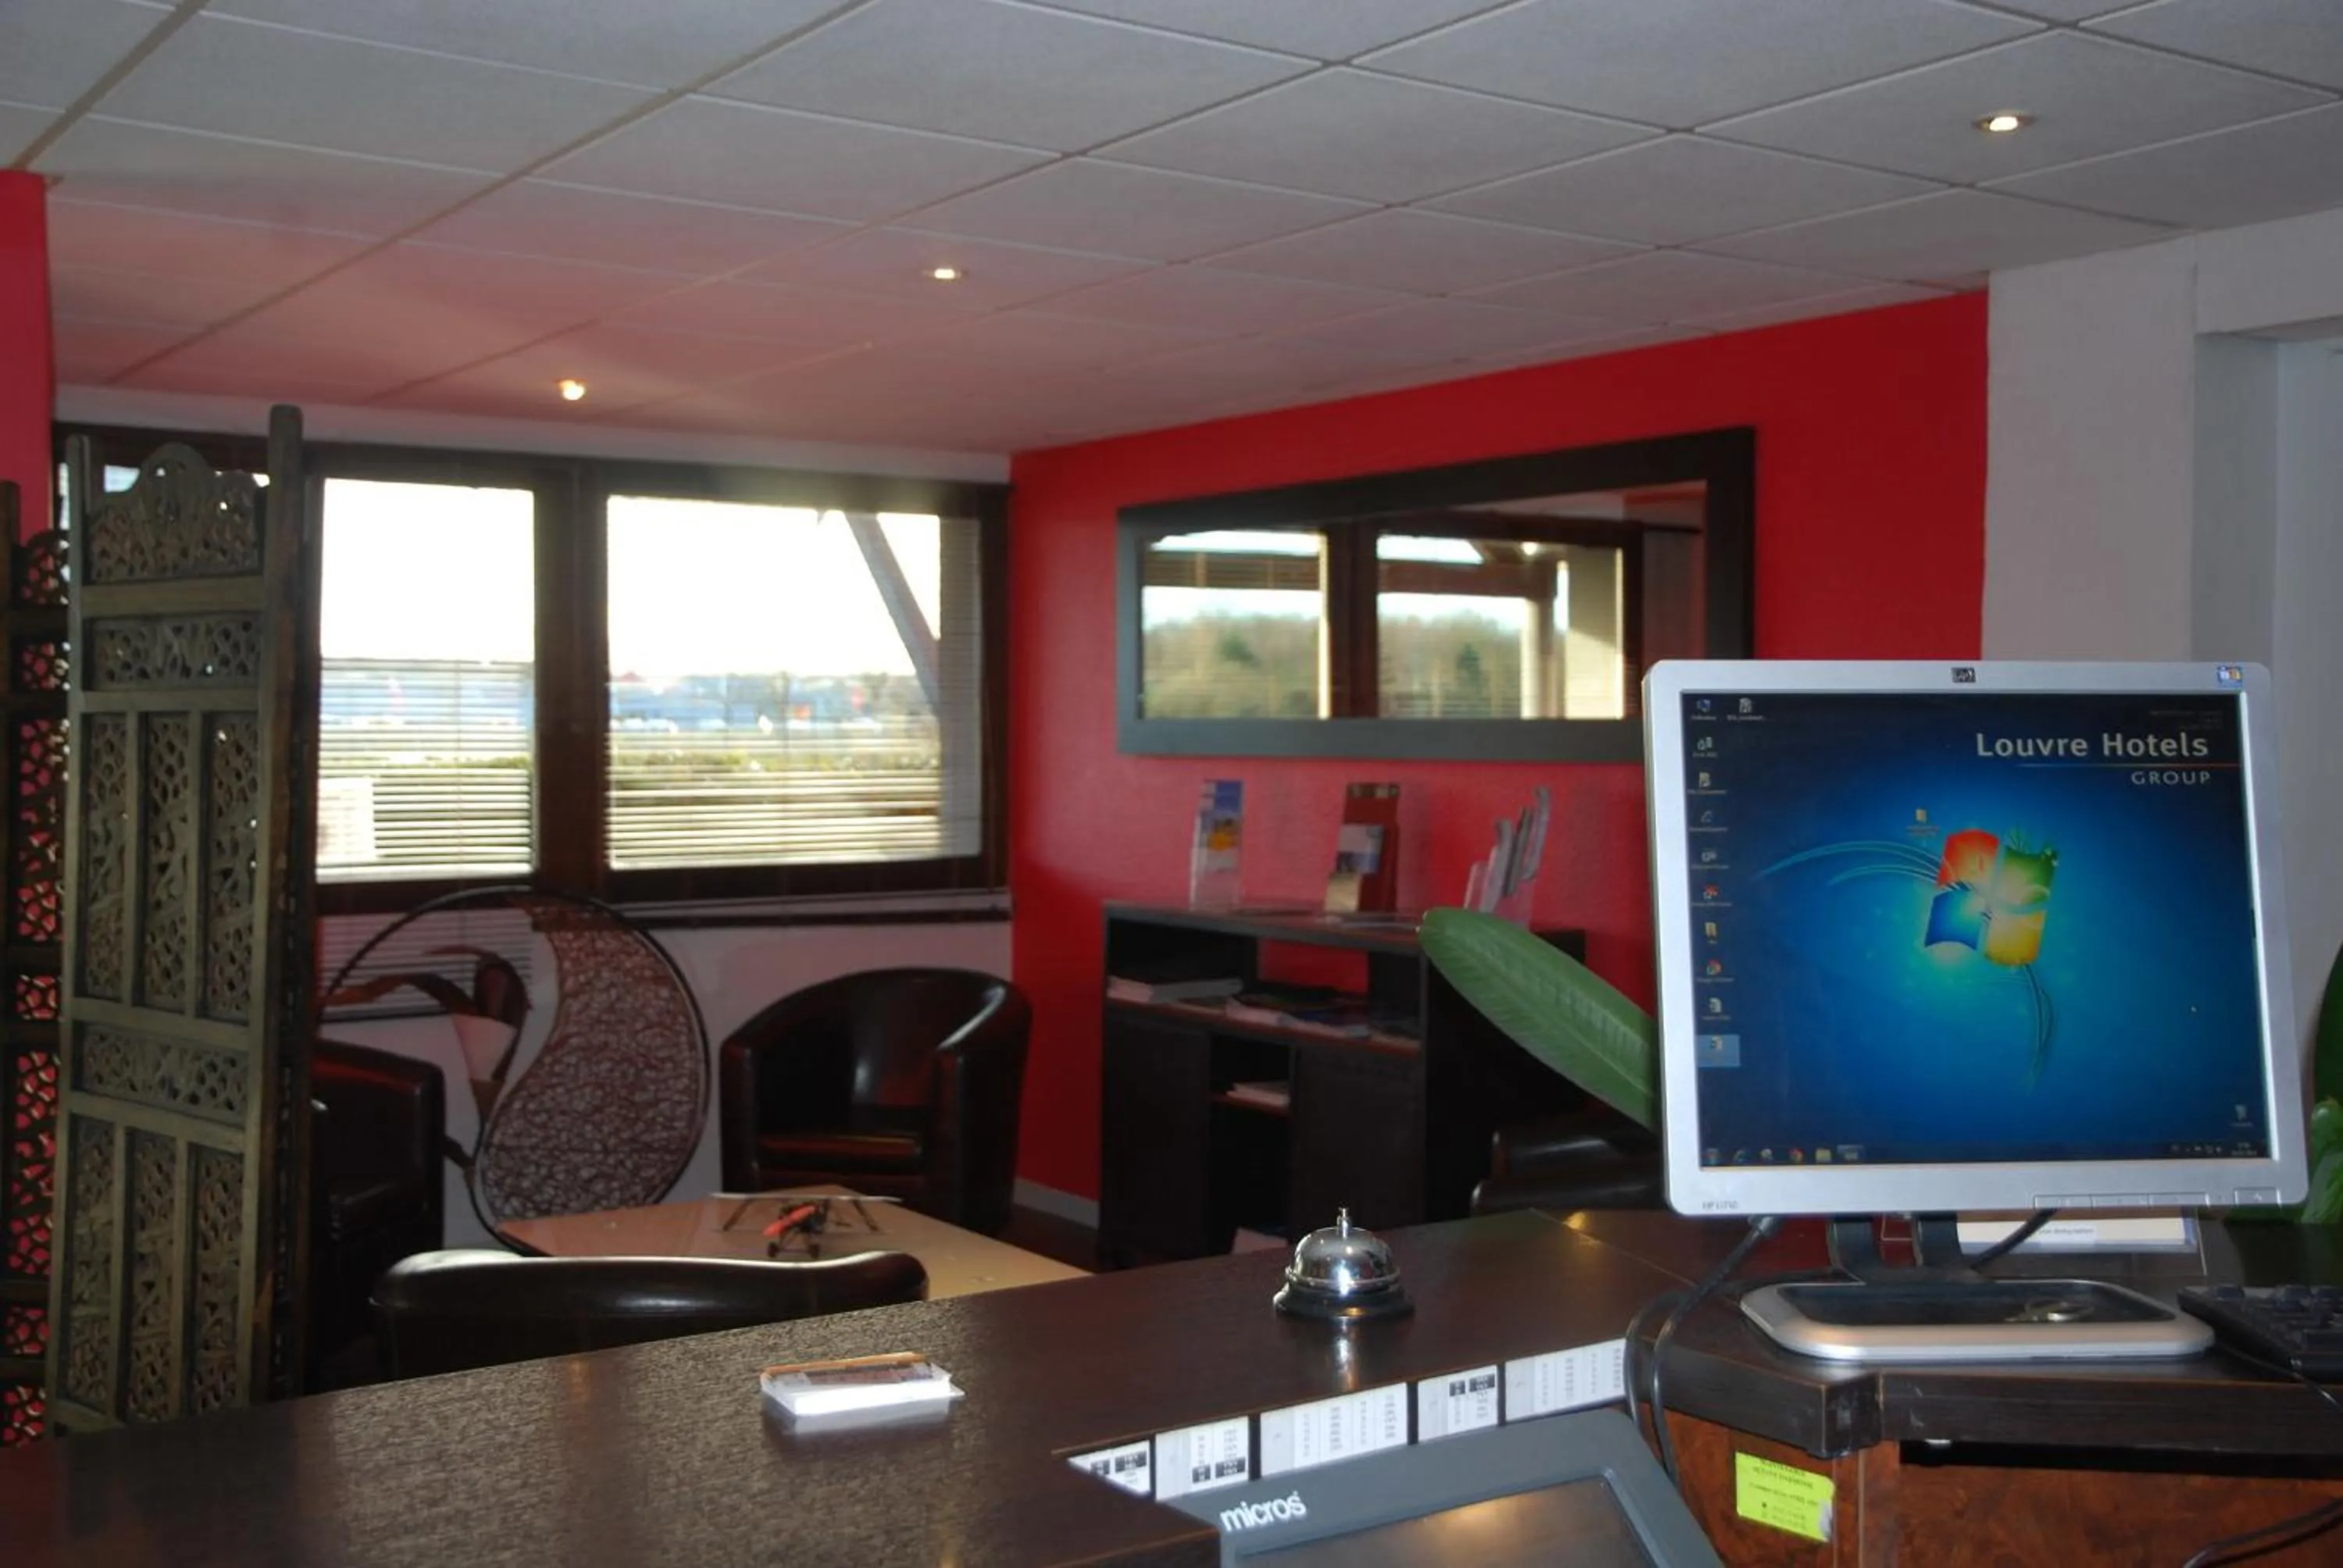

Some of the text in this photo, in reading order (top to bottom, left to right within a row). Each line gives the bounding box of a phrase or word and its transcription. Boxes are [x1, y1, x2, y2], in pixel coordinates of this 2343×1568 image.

[1976, 732, 2209, 757] Louvre Hotels
[2131, 771, 2211, 786] GROUP
[1219, 1494, 1307, 1532] micros
